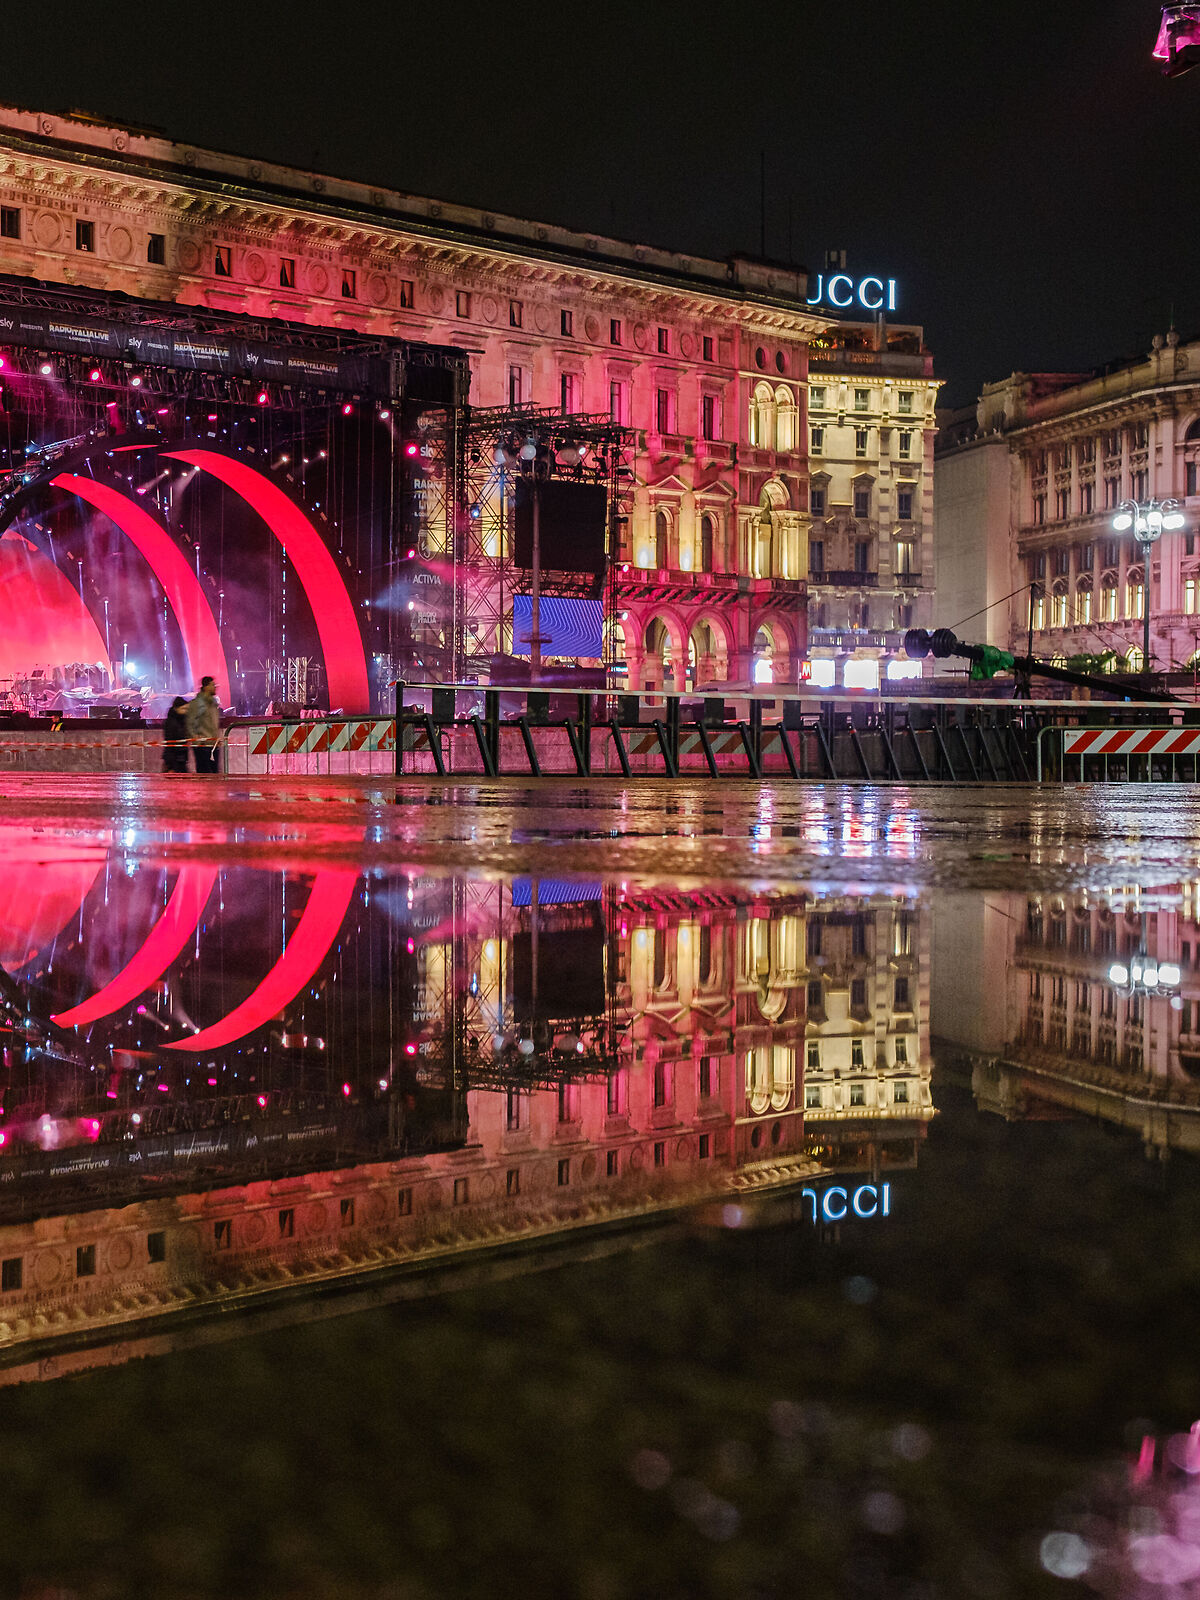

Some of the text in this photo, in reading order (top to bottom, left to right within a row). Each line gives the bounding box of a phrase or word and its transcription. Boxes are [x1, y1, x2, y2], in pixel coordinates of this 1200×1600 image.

[0, 317, 14, 330] sky
[128, 337, 142, 349] sky
[246, 353, 259, 365] sky
